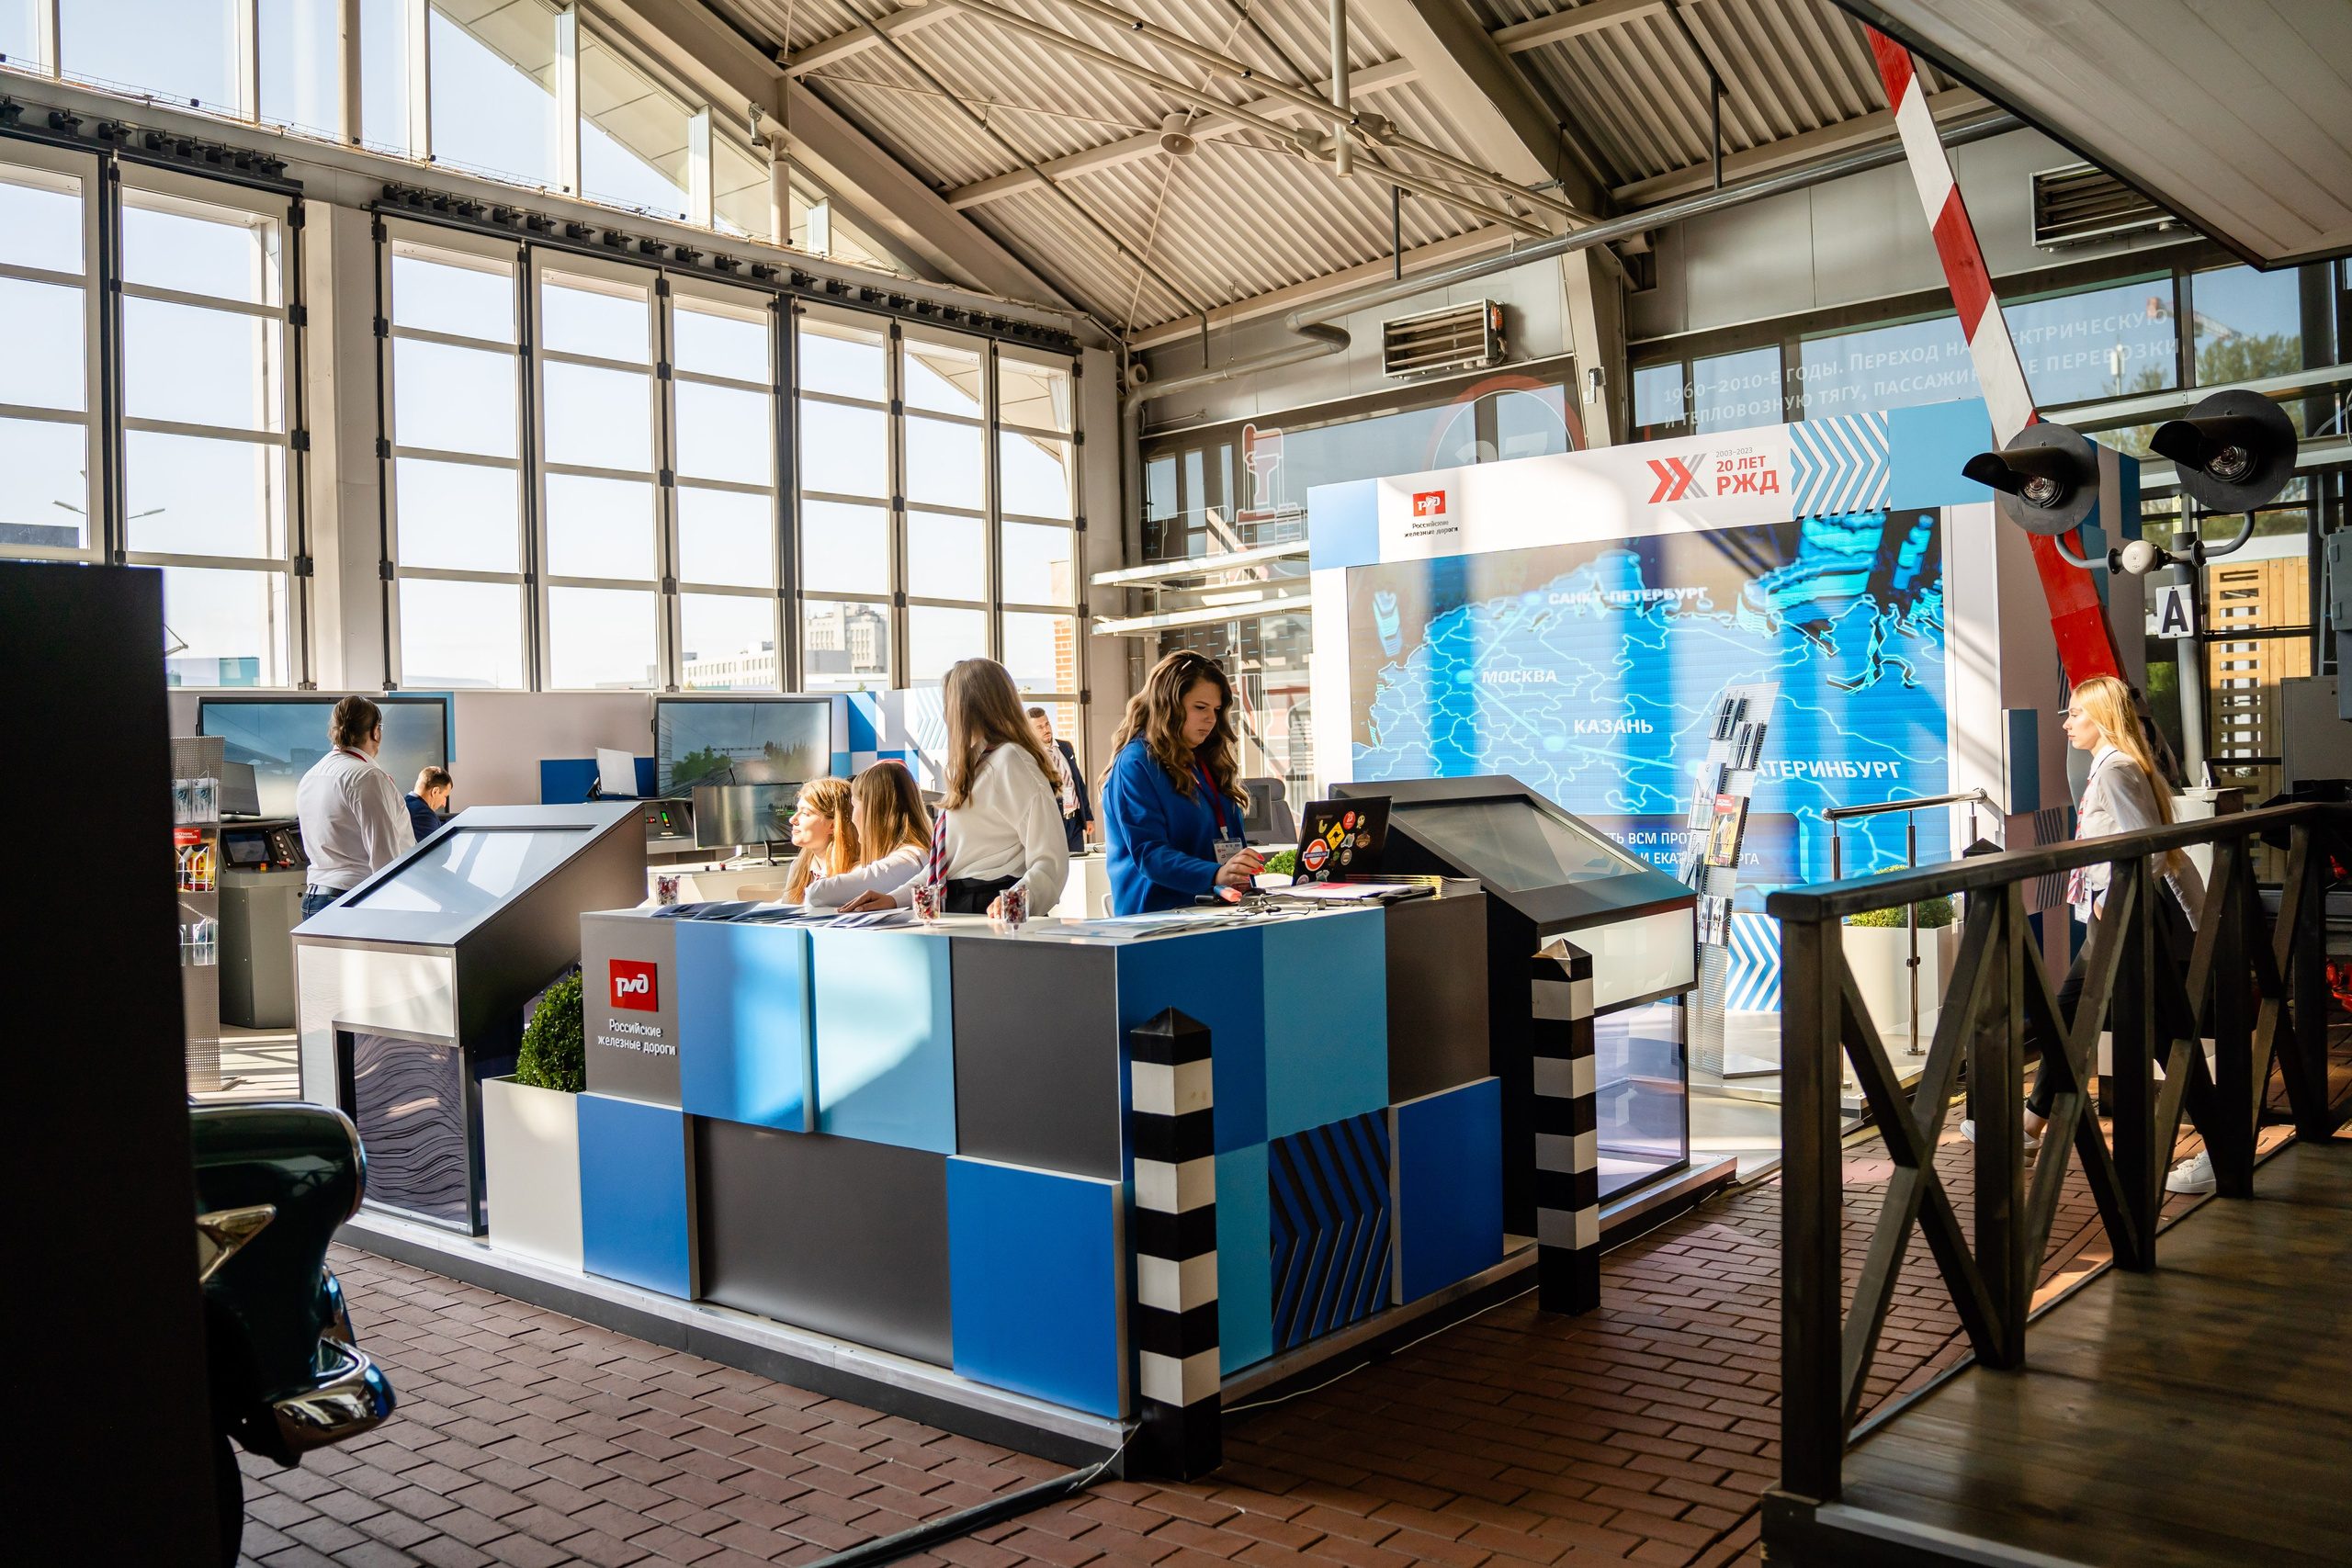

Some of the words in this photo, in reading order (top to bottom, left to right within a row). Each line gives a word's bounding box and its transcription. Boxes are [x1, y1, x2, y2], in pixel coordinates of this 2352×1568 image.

[1786, 362, 1843, 382] ГОДЫ.
[1665, 414, 1675, 429] И
[1682, 393, 1813, 426] ТЕПЛОВОЗНУЮ
[1819, 385, 1867, 406] ТЯГУ,
[2047, 338, 2179, 372] ПЕРЕВОЗКИ
[1716, 459, 1734, 472] 20
[1736, 456, 1766, 470] ЛЕТ
[1716, 469, 1780, 496] РЖД
[1548, 587, 1708, 605] САНКТ-ПЕТЕРБУРГ
[2162, 590, 2189, 634] А
[1482, 670, 1557, 683] МОСКВА
[1574, 719, 1654, 734] КАЗАНЬ
[1629, 832, 1657, 844] ВСМ
[609, 1018, 662, 1037] Российские
[598, 1035, 641, 1051] железные
[643, 1041, 676, 1055] дороги
